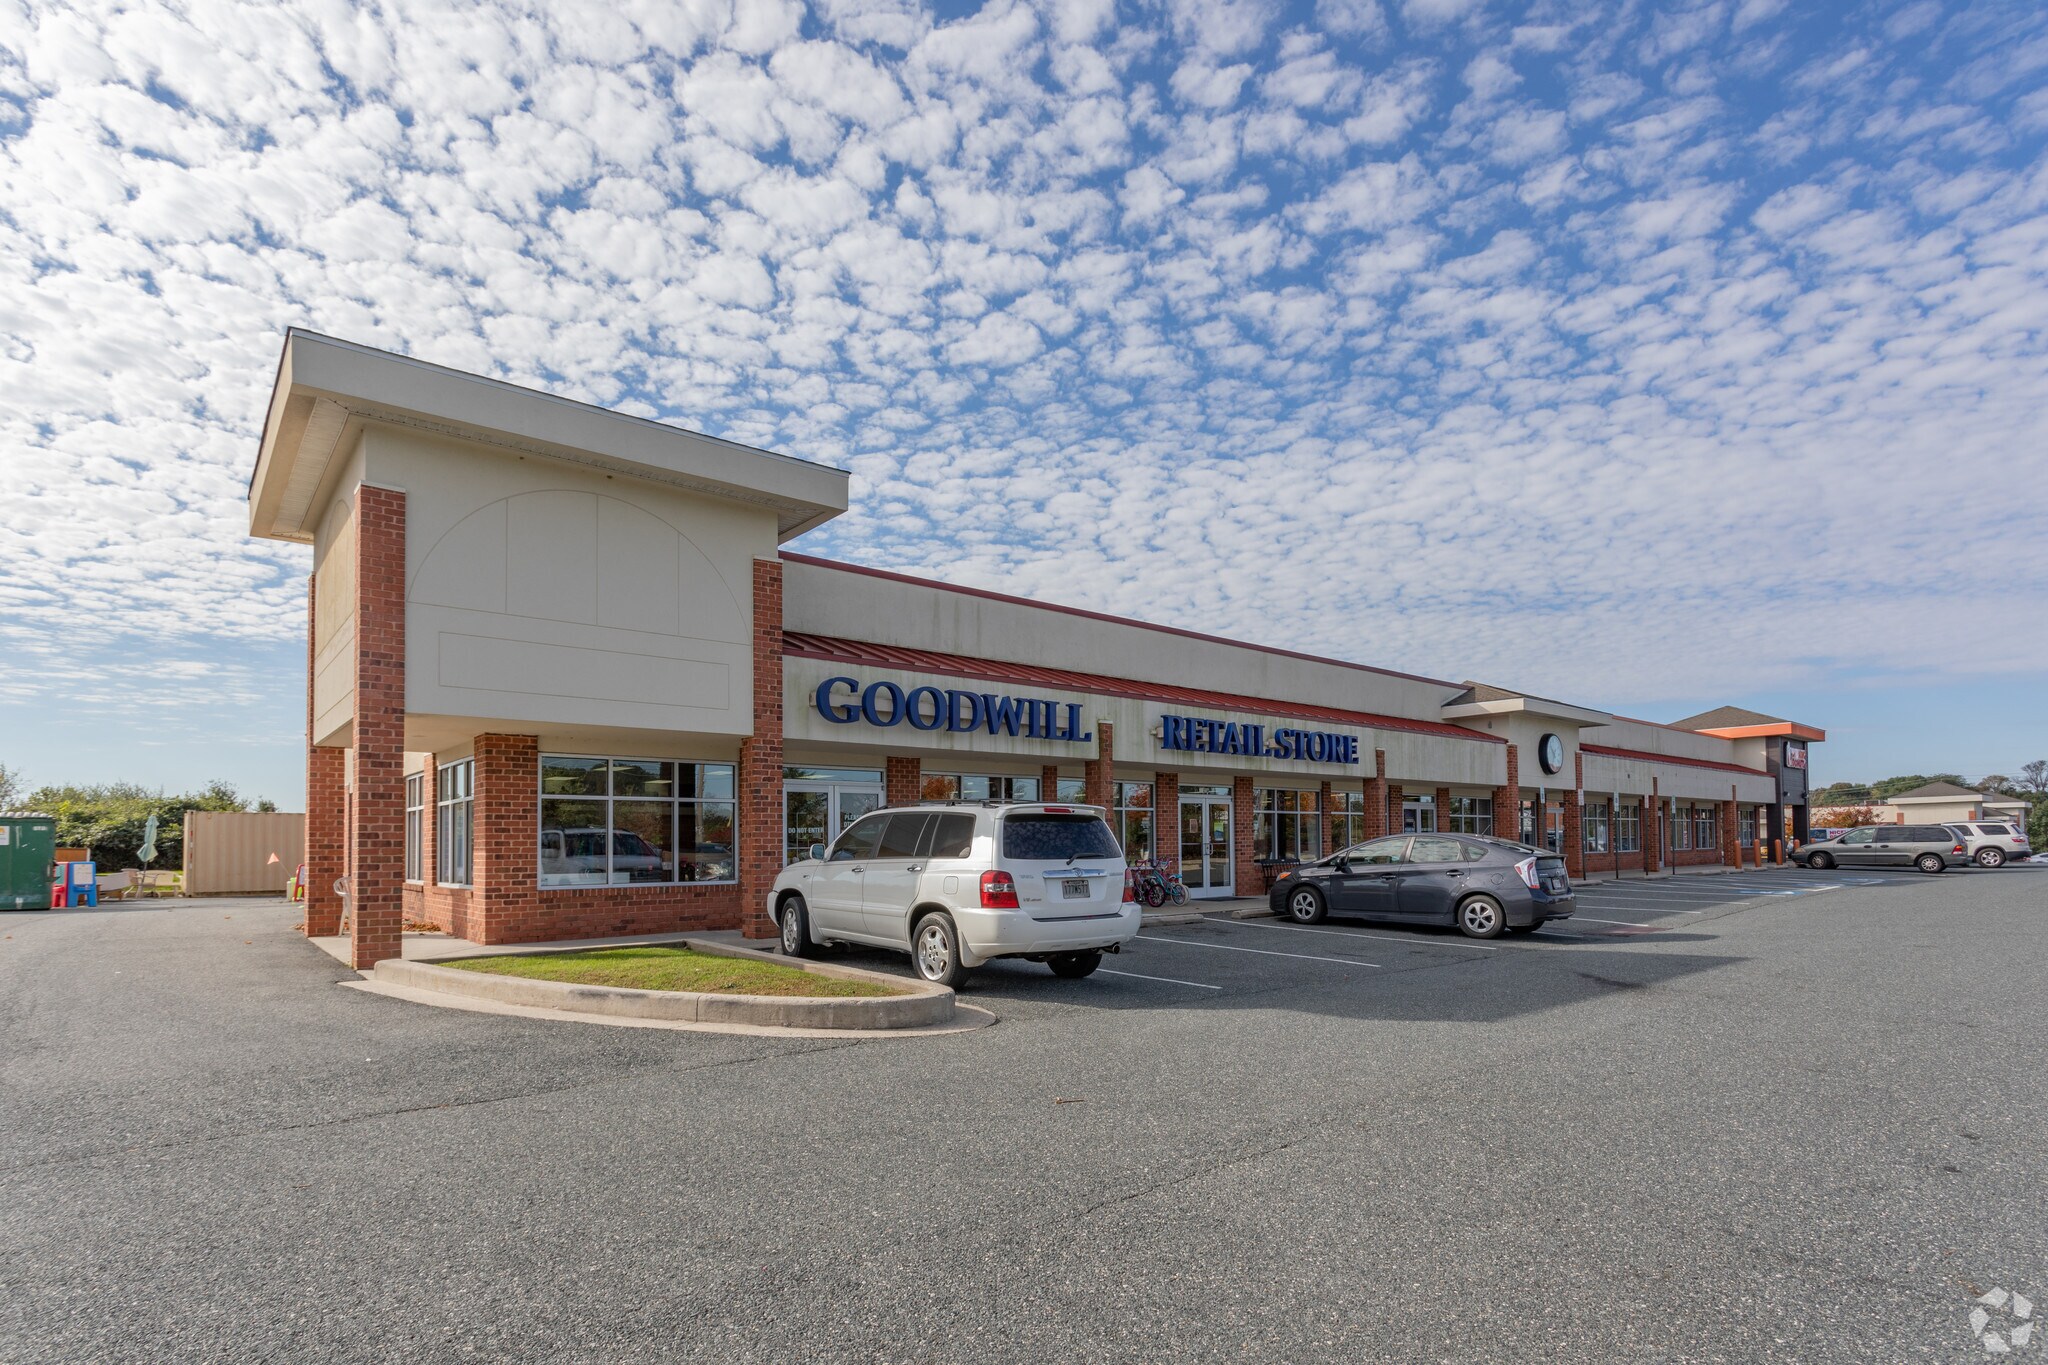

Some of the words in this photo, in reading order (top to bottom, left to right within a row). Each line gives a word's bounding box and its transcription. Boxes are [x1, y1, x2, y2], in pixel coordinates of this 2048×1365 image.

[815, 676, 1092, 743] GOODWILL
[1160, 714, 1272, 757] RETAIL
[1273, 727, 1360, 765] STORE
